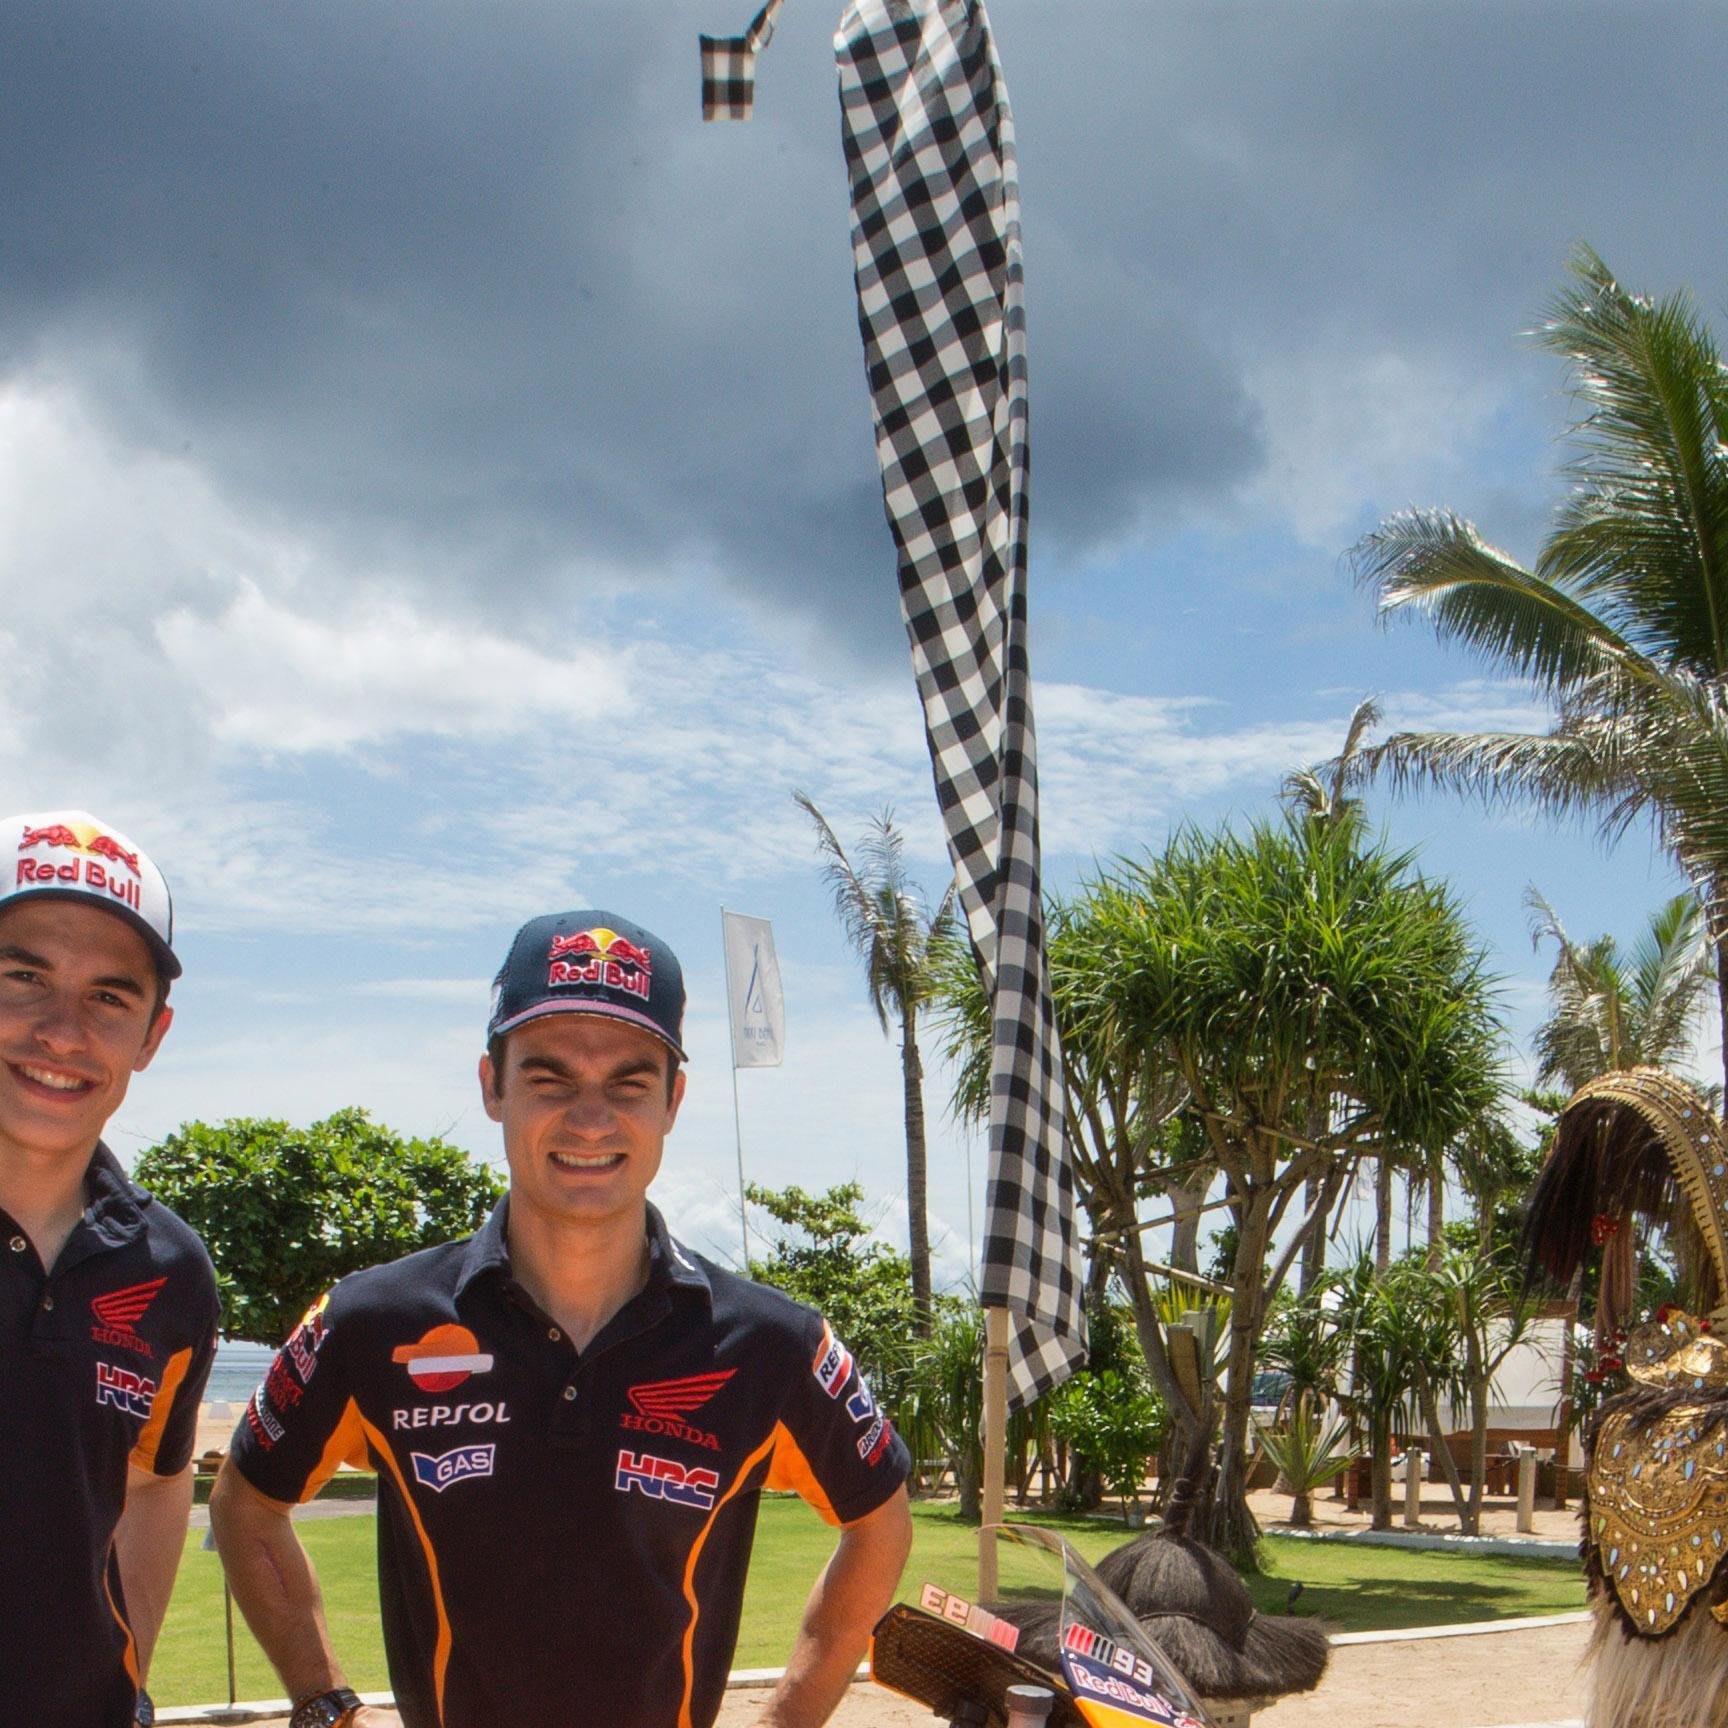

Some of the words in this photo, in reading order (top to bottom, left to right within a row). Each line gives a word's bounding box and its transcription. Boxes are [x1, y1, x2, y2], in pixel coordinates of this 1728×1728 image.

[16, 857, 80, 885] Red
[85, 860, 140, 911] Bull
[548, 958, 602, 988] Red
[603, 961, 651, 1002] Bull
[91, 1326, 154, 1359] HONDA
[95, 1361, 158, 1420] HRC
[392, 1401, 512, 1431] REPSOL
[619, 1412, 721, 1451] HONDA
[436, 1451, 491, 1482] GAS
[614, 1449, 720, 1511] HRC
[1069, 1661, 1126, 1702] Red
[1112, 1646, 1153, 1687] 93
